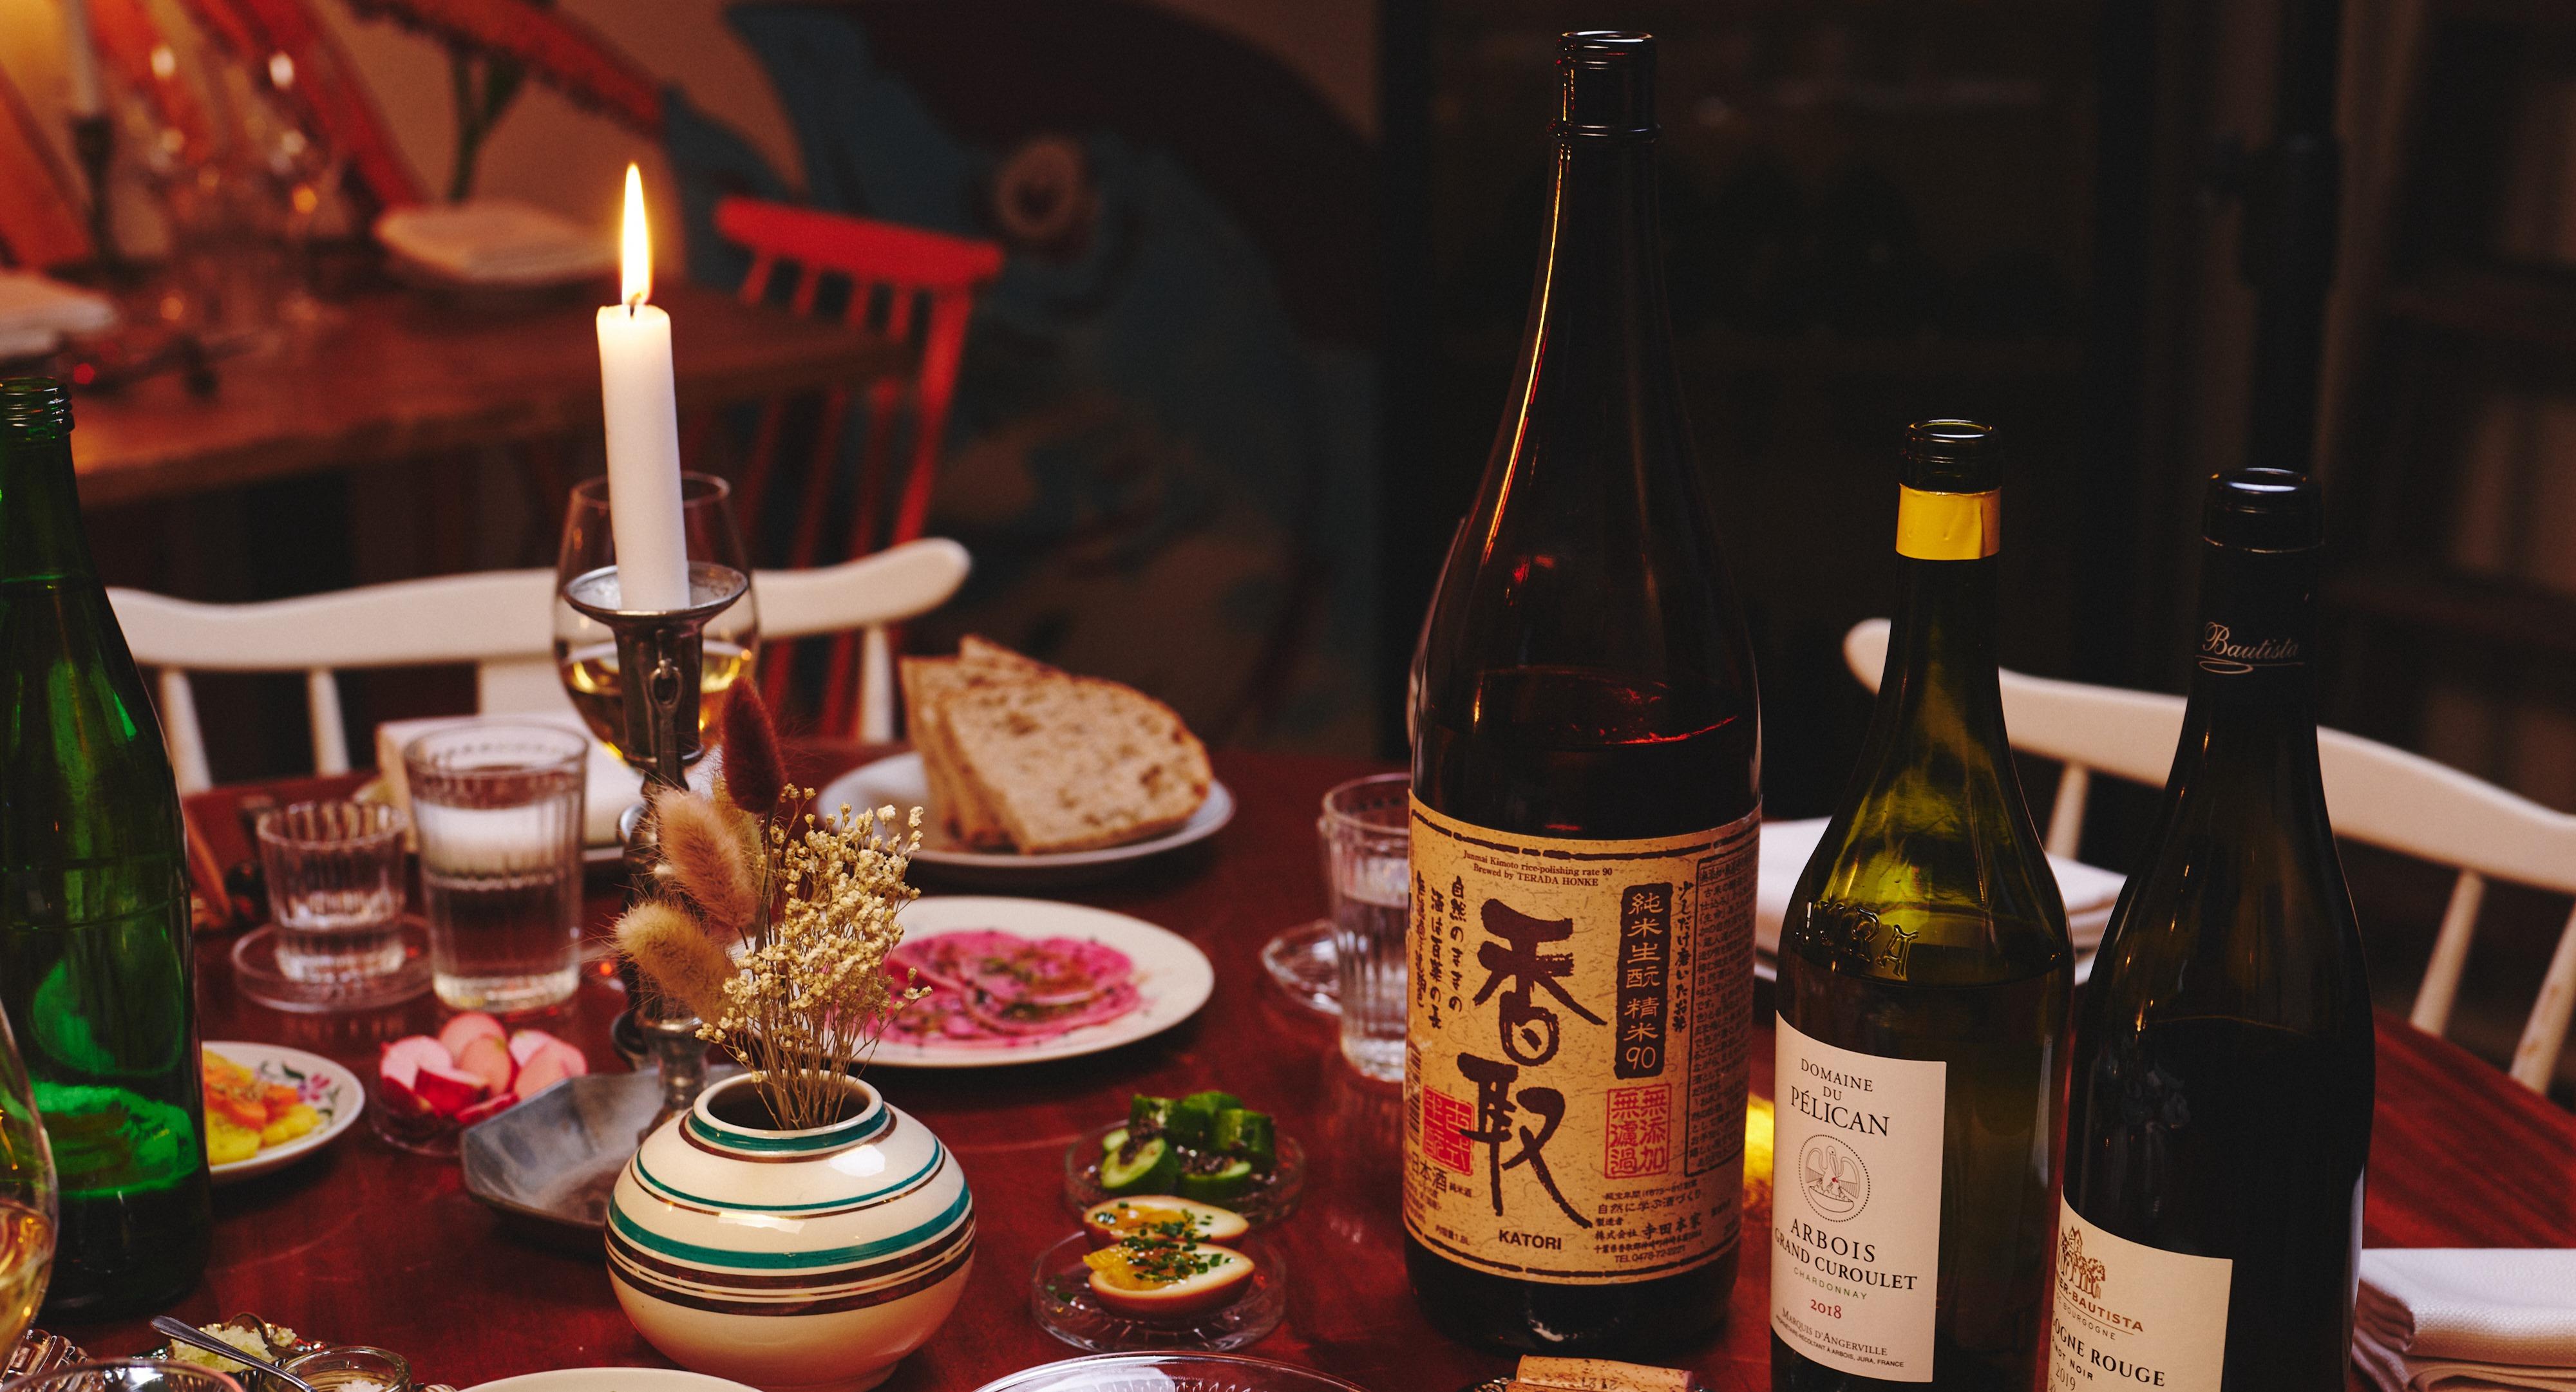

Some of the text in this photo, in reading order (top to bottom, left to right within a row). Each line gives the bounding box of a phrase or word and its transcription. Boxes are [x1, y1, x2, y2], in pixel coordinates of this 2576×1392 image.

[2202, 621, 2300, 660] Bautista
[1463, 849, 1488, 864] Junmai
[1490, 856, 1519, 869] Kimoto
[1521, 863, 1579, 877] rice-polishing
[1602, 867, 1613, 876] 90
[1473, 863, 1598, 887] Brewed by TERADA HONKE
[1801, 1057, 1873, 1092] DOMAINE
[1823, 1086, 1842, 1101] DU
[1790, 1085, 1890, 1137] PÉLICAN
[1640, 1089, 1669, 1176] 無添加
[1499, 1230, 1562, 1250] KATORI
[1790, 1218, 1875, 1263] ARBOIS
[1615, 1255, 1631, 1263] TEL
[1774, 1227, 1918, 1290] GRAND CUROULET
[1793, 1266, 1868, 1300] CHARDONNAY
[1810, 1299, 1842, 1319] 2018
[2057, 1275, 2143, 1332] ER-BAUTISTA
[2063, 1302, 2116, 1340] BOURGOGNE
[1832, 1348, 1855, 1361] ARBOIS,
[1857, 1355, 1875, 1365] JURA,
[1877, 1359, 1905, 1368] FRANCE
[2070, 1359, 2094, 1381] NOIR
[2090, 1348, 2165, 1387] ROUGE
[2056, 1362, 2076, 1391] 2019
